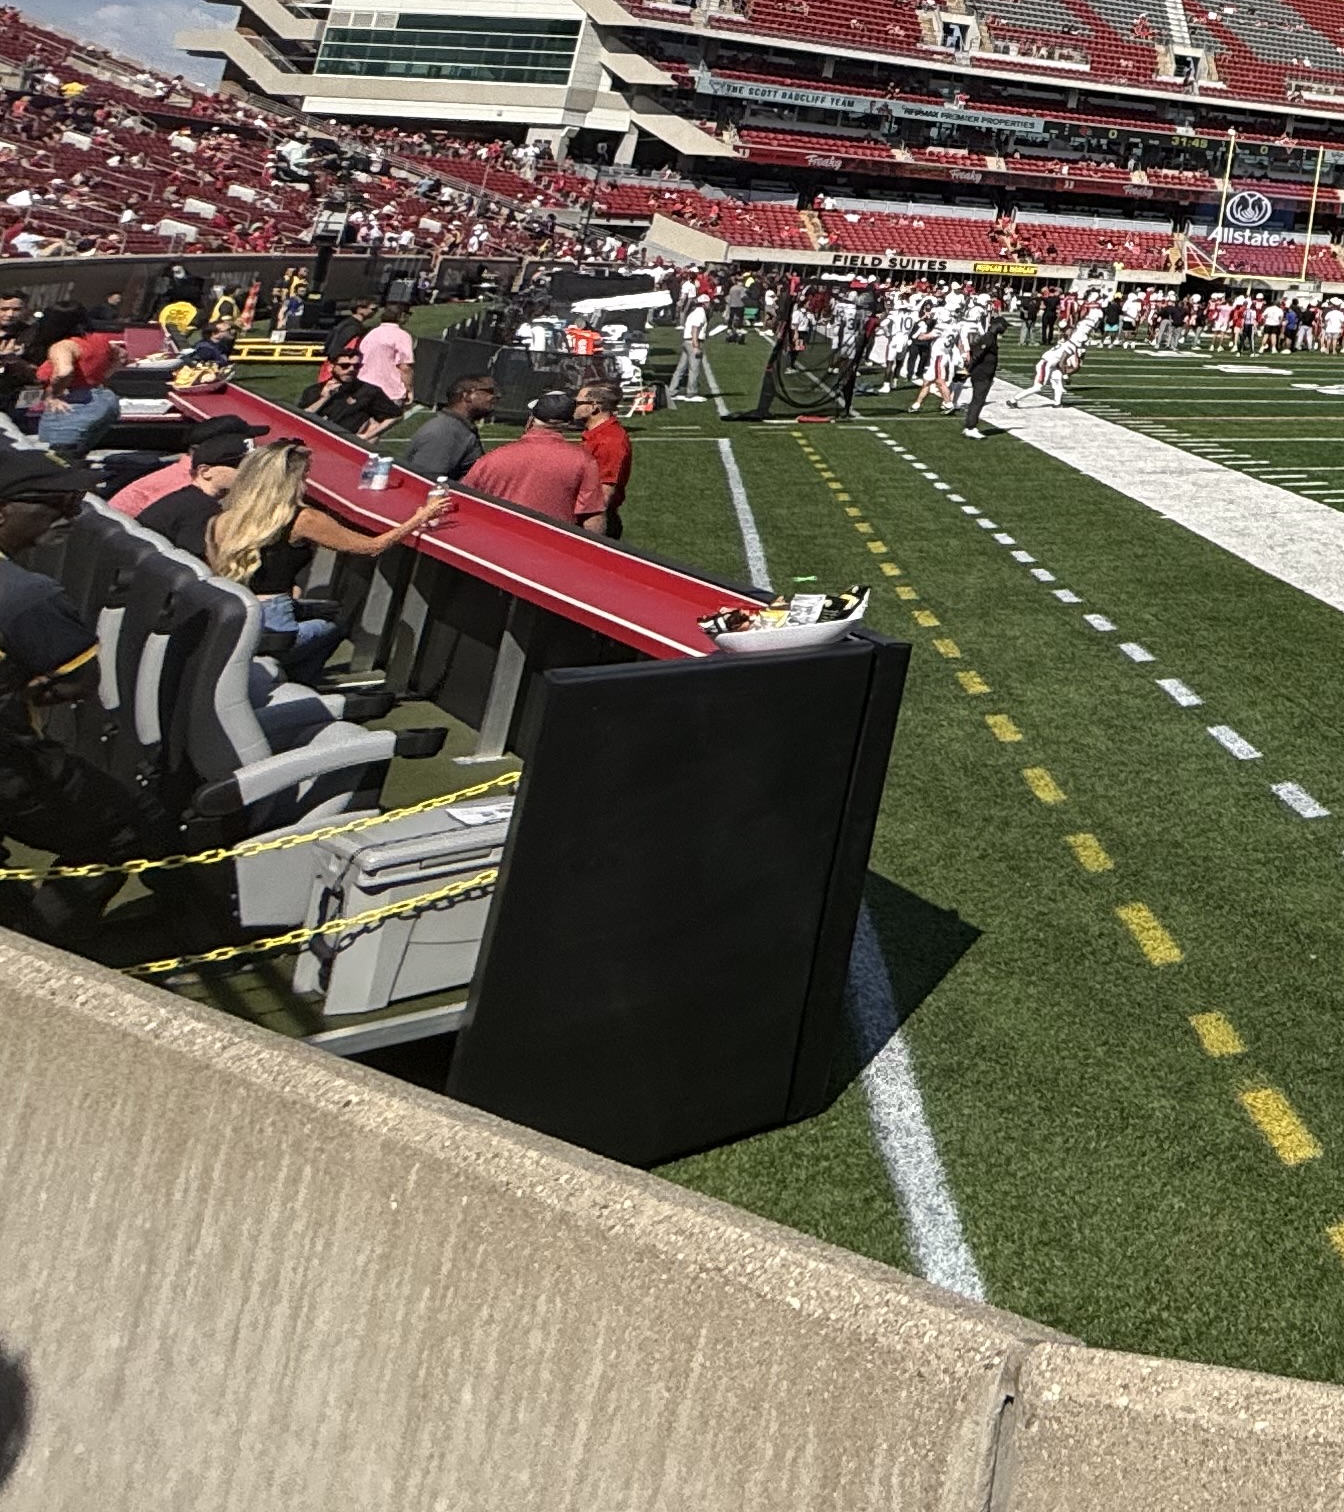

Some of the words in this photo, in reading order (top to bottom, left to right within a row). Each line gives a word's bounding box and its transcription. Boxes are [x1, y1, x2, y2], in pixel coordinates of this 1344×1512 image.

[748, 87, 778, 99] SCOTT
[829, 97, 855, 108] TEAM
[981, 115, 1036, 129] PROPERTIES
[1207, 226, 1282, 247] Allstate
[832, 254, 882, 267] FIELD
[888, 257, 948, 271] SUITES
[900, 316, 913, 330] 10
